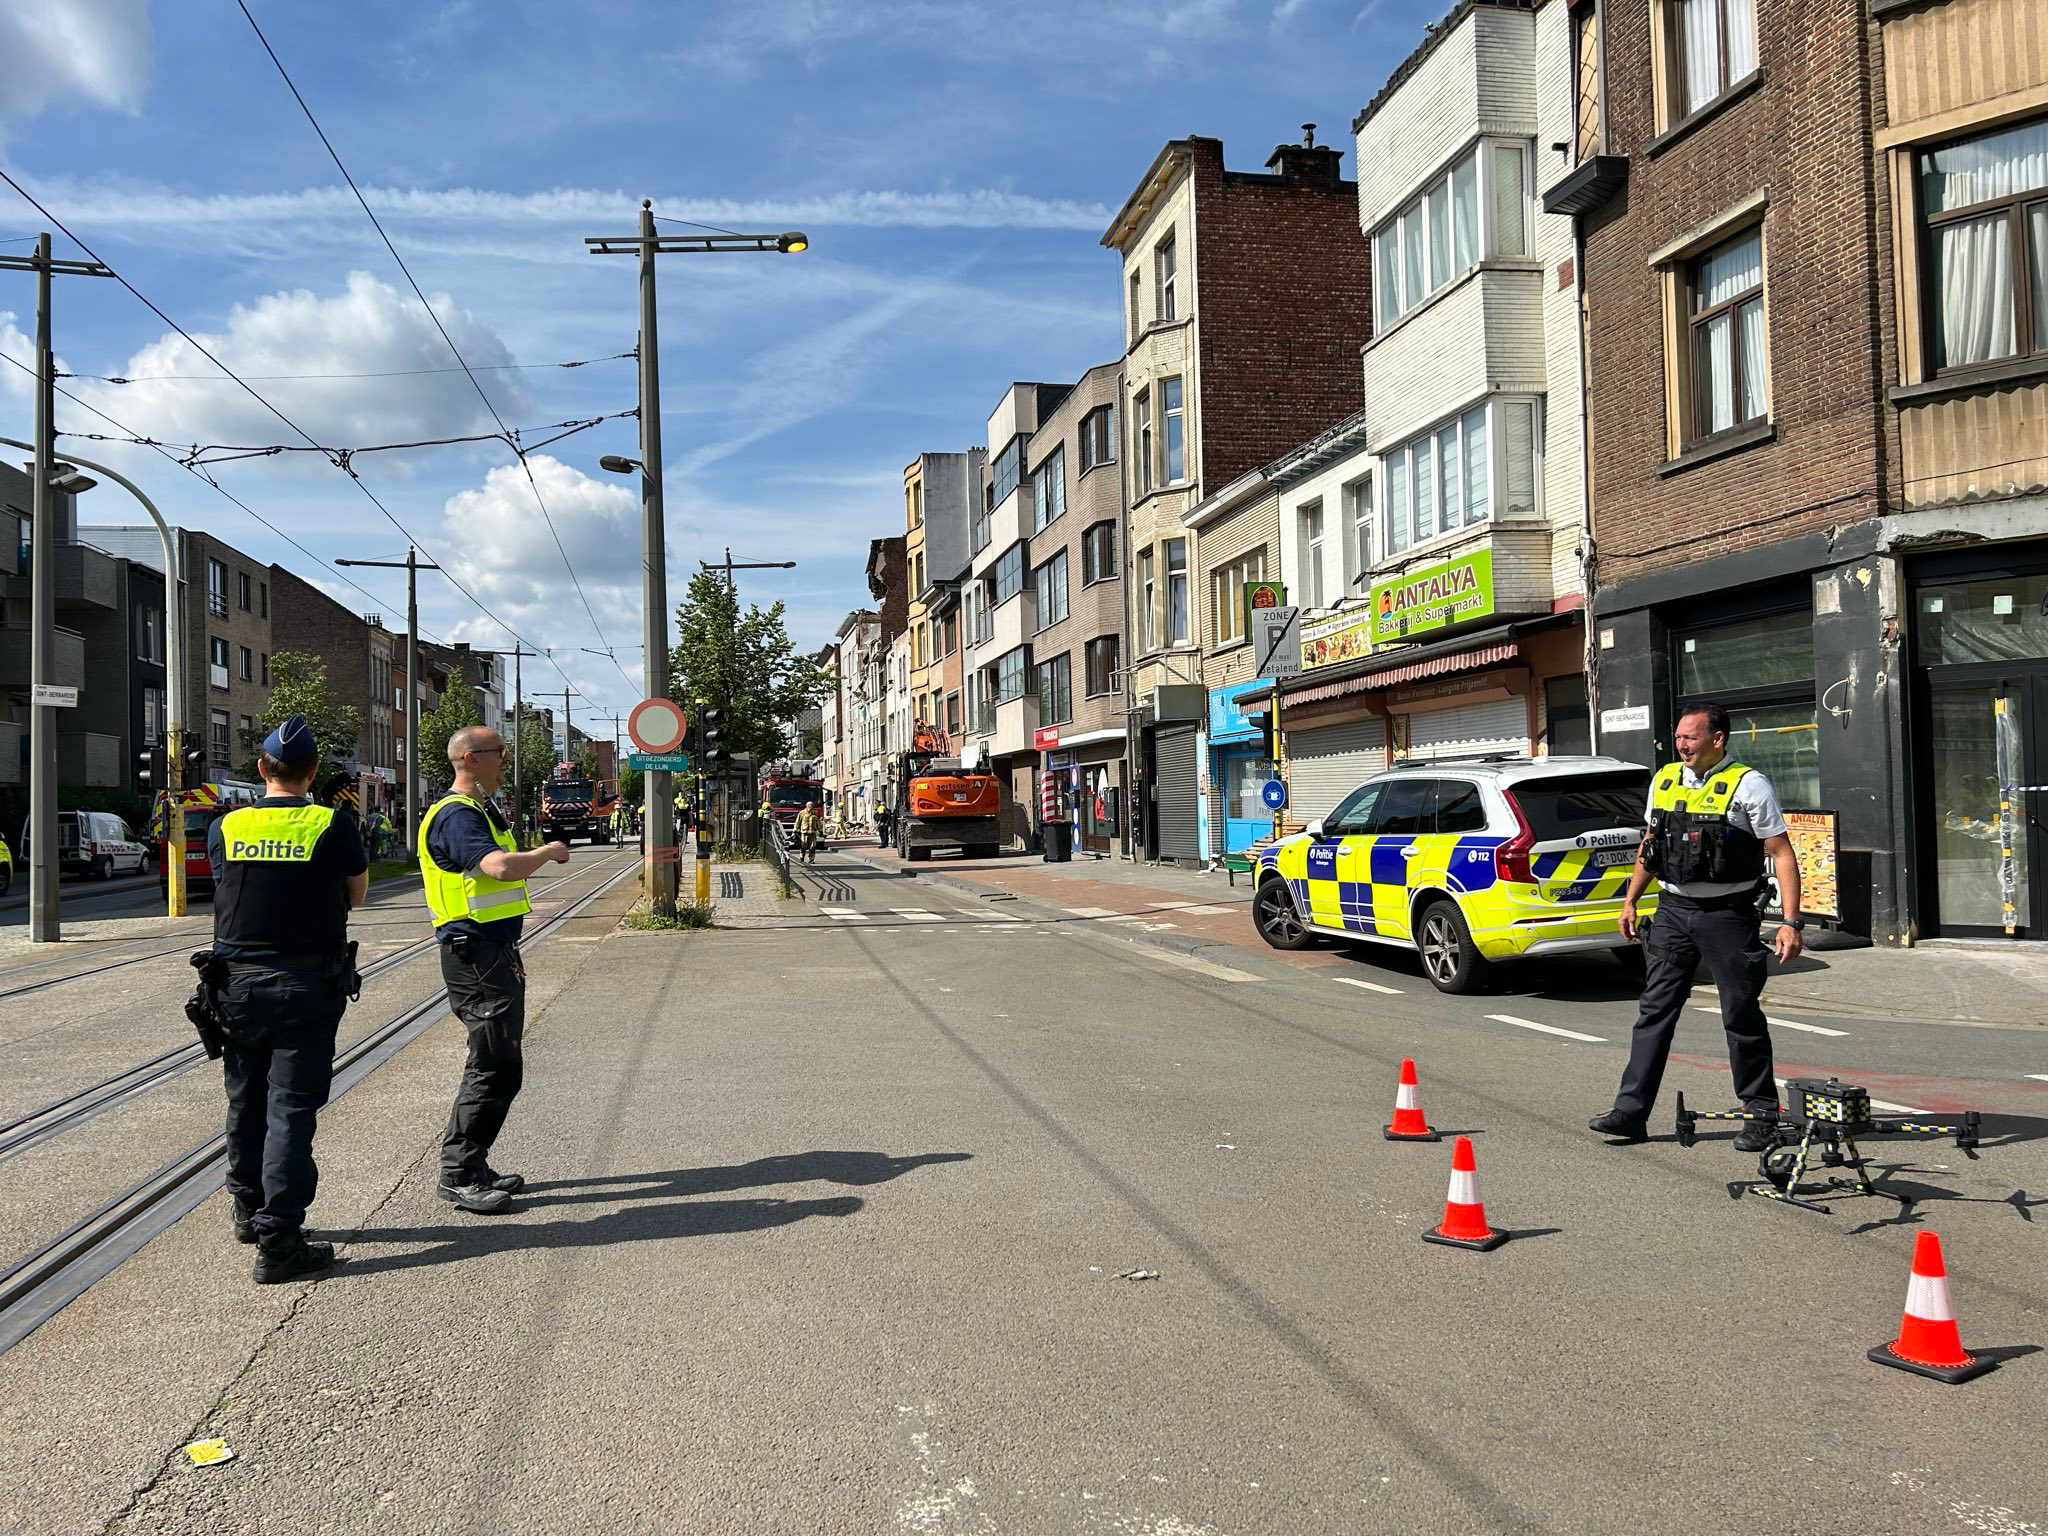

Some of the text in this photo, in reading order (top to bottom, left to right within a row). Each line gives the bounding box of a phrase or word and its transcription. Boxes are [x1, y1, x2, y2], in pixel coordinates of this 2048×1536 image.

[1394, 565, 1476, 612] ANTALYA
[1263, 611, 1289, 621] ZONE
[1378, 593, 1483, 634] Bakkerij & Supermarkt
[936, 782, 969, 790] aertssen
[1790, 814, 1826, 826] ANTALYA
[1590, 833, 1627, 846] Politie
[233, 839, 306, 859] Politie
[1315, 848, 1333, 860] Politie
[1477, 852, 1490, 861] 112
